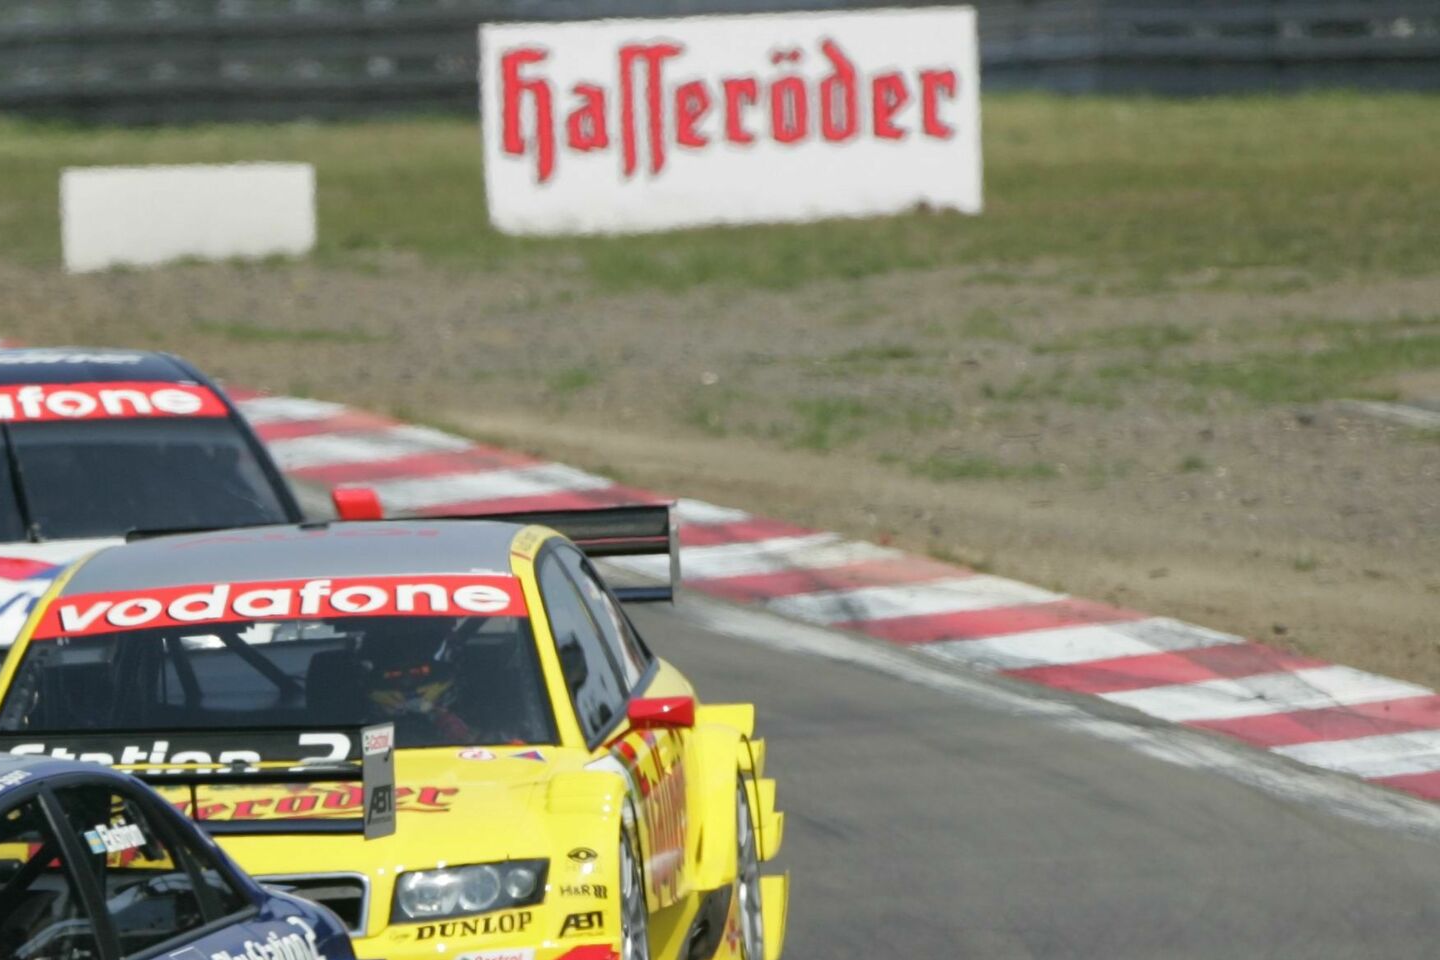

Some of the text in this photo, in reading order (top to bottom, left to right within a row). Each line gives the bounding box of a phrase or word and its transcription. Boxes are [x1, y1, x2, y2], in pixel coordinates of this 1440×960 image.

[59, 580, 512, 632] vodafone
[415, 911, 533, 941] DUNLOP
[557, 910, 604, 939] ABT
